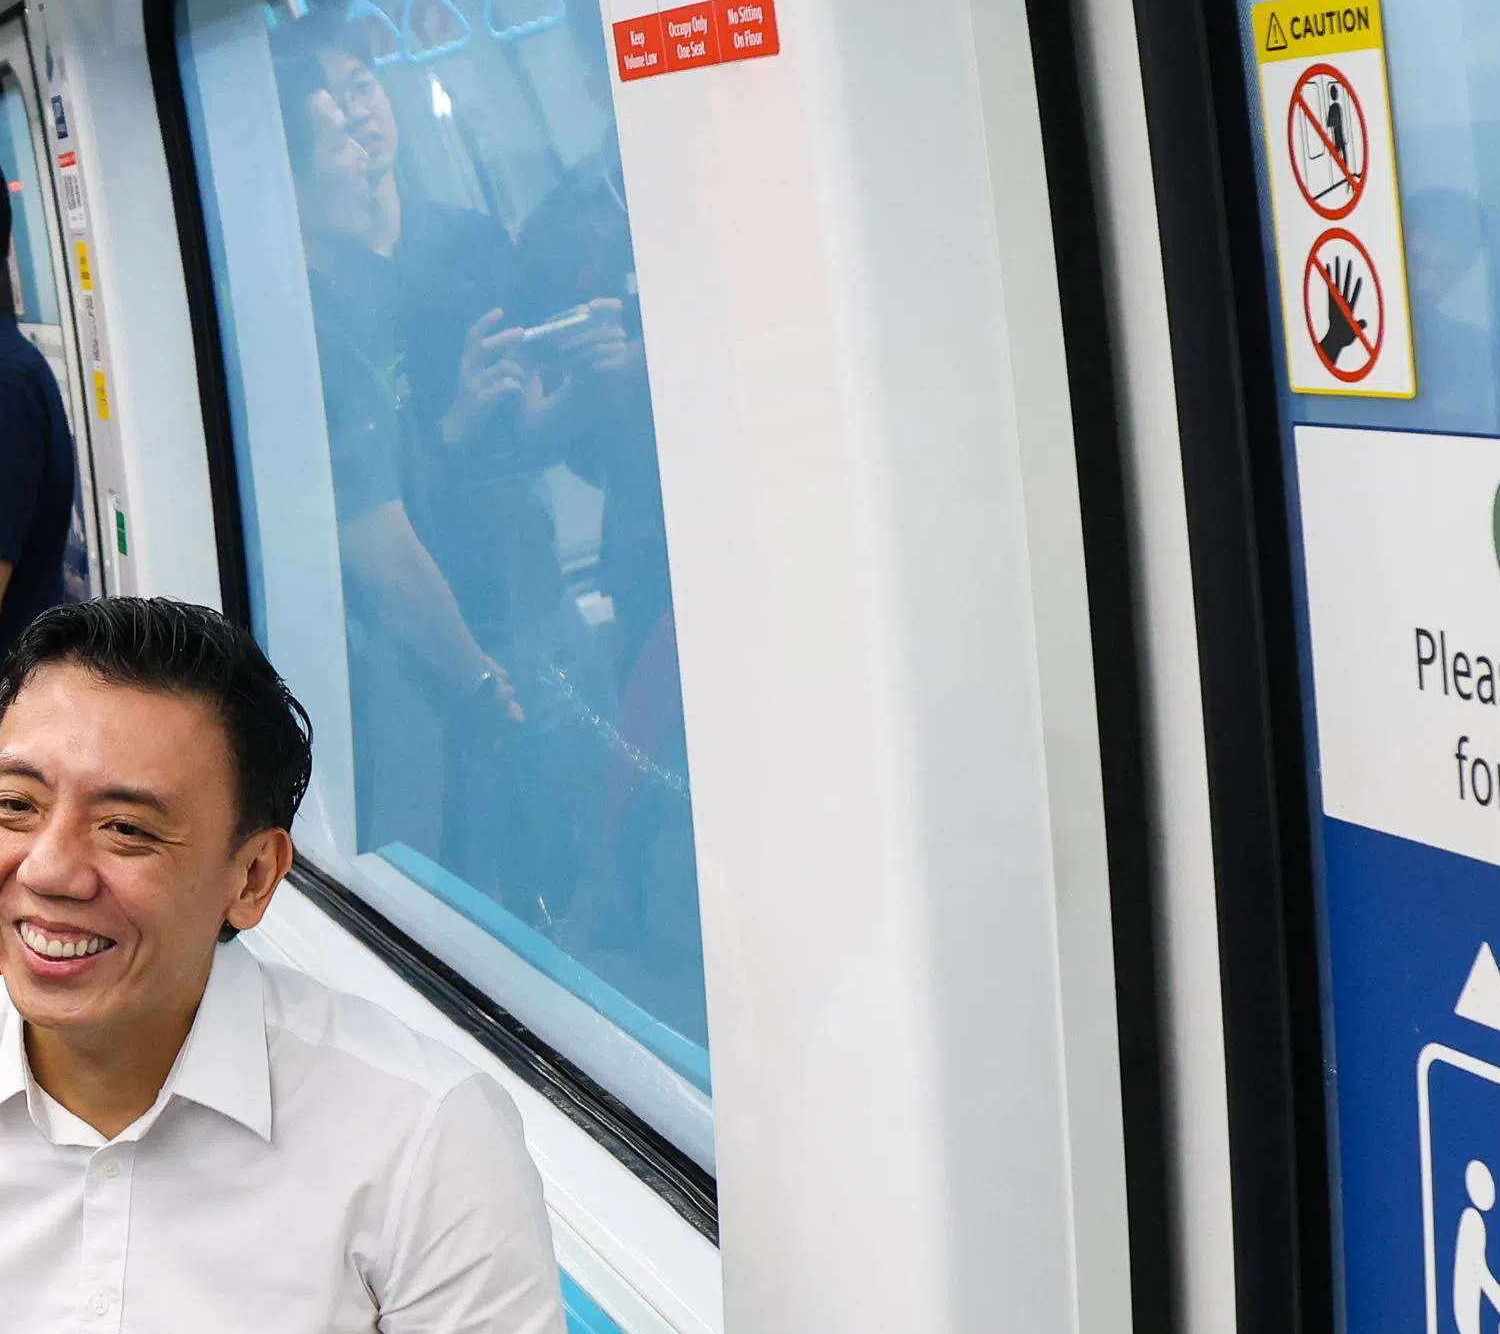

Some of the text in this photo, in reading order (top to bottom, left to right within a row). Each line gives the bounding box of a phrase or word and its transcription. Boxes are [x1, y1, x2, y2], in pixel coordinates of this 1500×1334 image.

[727, 3, 763, 25] No Sitting
[1289, 5, 1371, 41] CAUTION
[668, 15, 708, 38] Occupy Only
[629, 30, 645, 48] Keep
[733, 30, 763, 48] On Floor
[676, 41, 706, 60] One Seat
[623, 51, 658, 70] Volume Low
